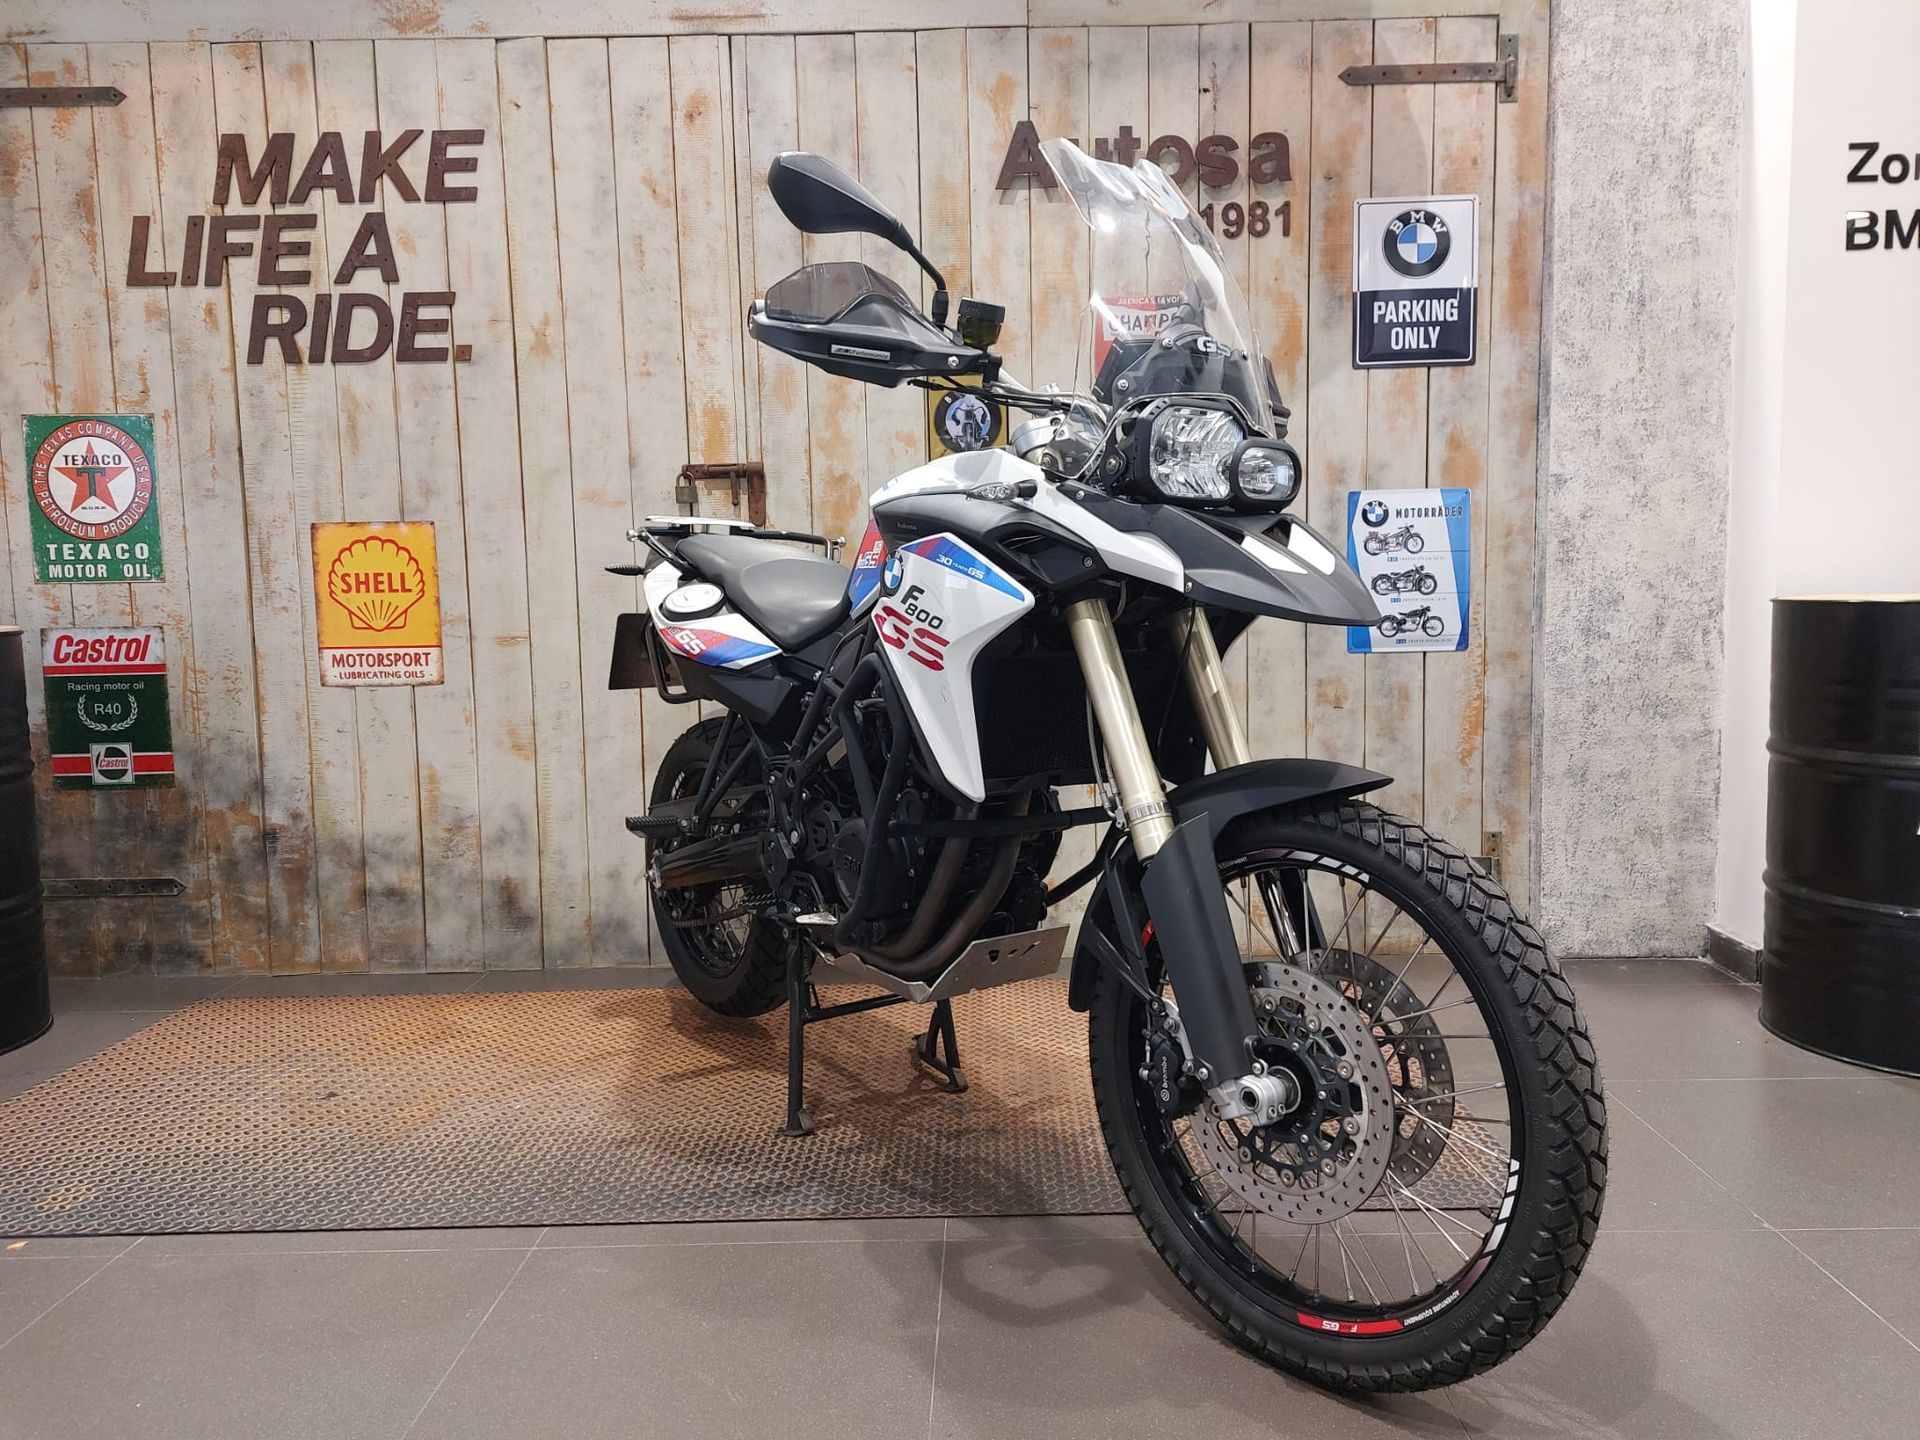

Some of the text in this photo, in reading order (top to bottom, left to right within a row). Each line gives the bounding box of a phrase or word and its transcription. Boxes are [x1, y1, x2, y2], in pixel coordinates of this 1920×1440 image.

[213, 129, 485, 205] MAKE
[1389, 210, 1447, 235] BMW
[126, 211, 400, 286] LIFE A
[1373, 298, 1459, 324] PARKING
[247, 291, 473, 364] RIDE.
[1390, 325, 1441, 351] ONLY
[1196, 336, 1232, 357] GS
[42, 426, 73, 458] TEXAS
[77, 423, 135, 452] COMPANY
[62, 454, 122, 466] TEXACO
[34, 461, 47, 485] THE
[76, 467, 106, 497] T
[37, 489, 149, 537] PETROLEUM PRODUCTS
[46, 542, 150, 561] TEXACO
[49, 563, 151, 579] MOTOR OIL
[936, 554, 953, 567] 30
[967, 566, 985, 579] GS
[340, 572, 413, 594] SHELL
[900, 584, 925, 606] F
[904, 603, 943, 630] 800
[53, 634, 152, 664] Castrol
[674, 629, 707, 656] GS
[874, 606, 950, 671] GS
[332, 652, 431, 668] MOTORSPORT
[67, 682, 101, 692] Racing
[133, 681, 145, 690] oil
[339, 670, 425, 680] LUBRICATING OILS
[94, 703, 122, 716] R40
[99, 757, 129, 769] Castrol
[1321, 1320, 1340, 1332] GS
